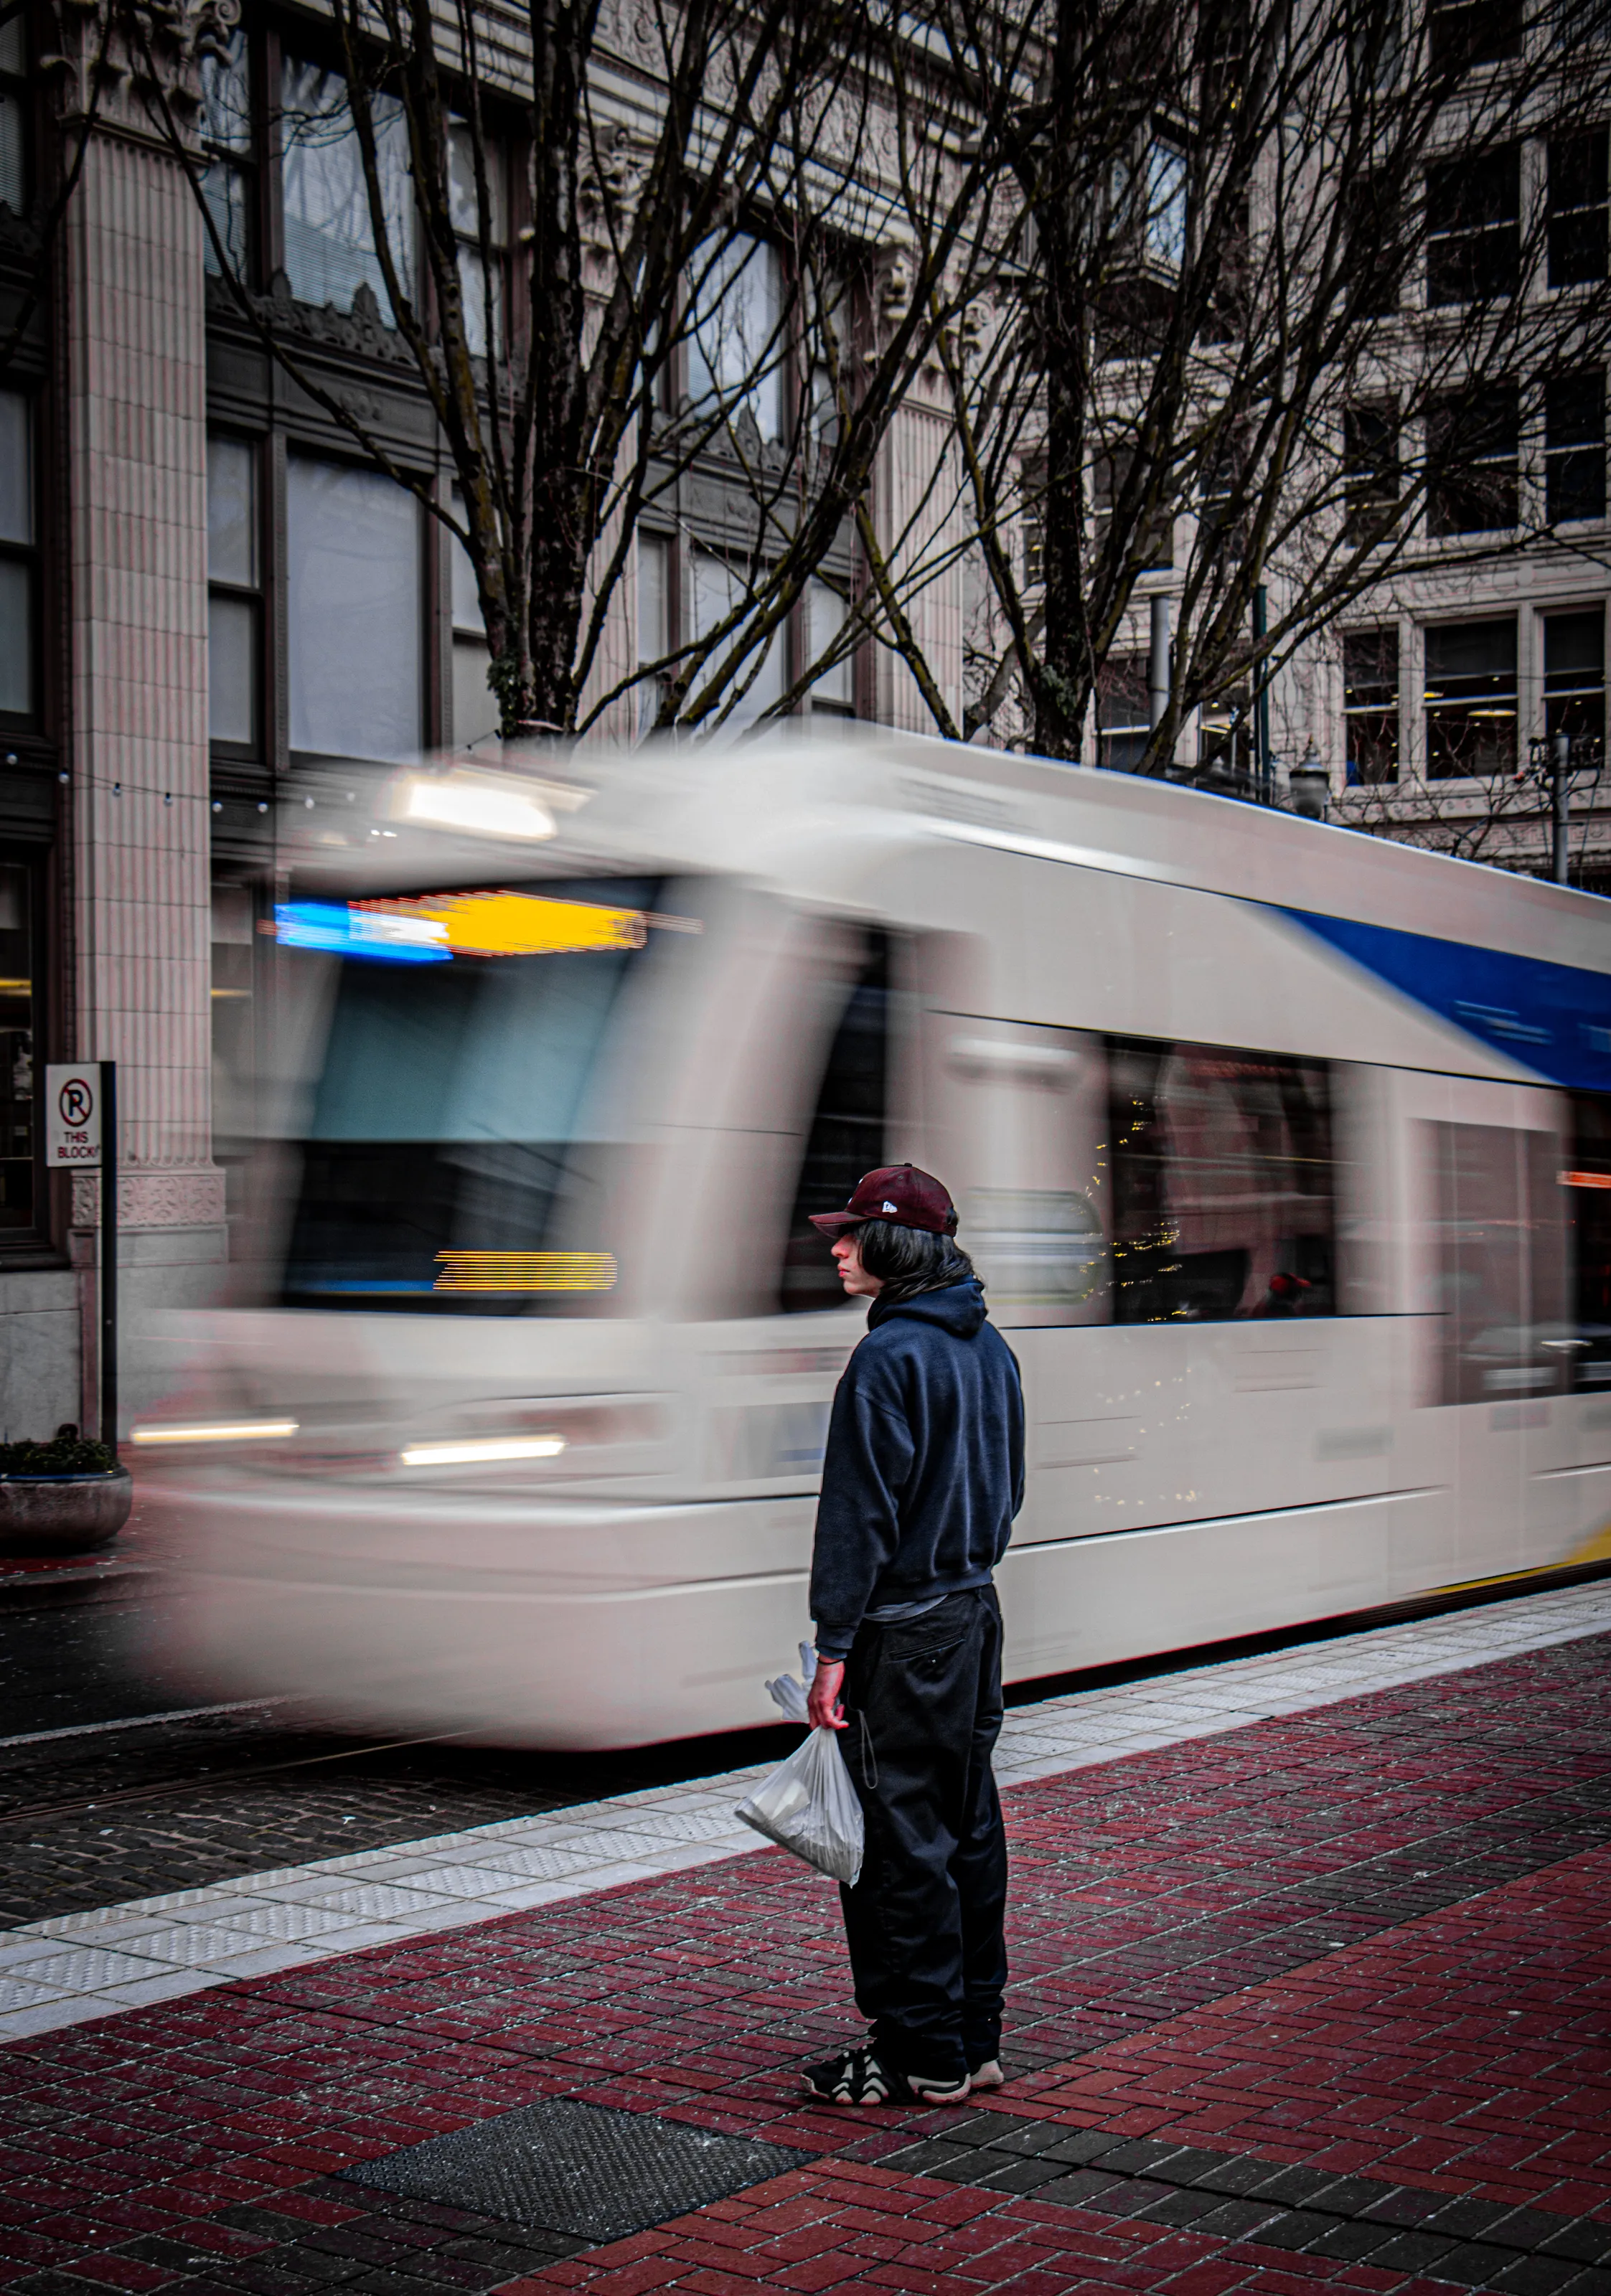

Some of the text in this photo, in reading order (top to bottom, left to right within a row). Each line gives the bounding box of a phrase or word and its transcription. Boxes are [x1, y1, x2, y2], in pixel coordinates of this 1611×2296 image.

[68, 1089, 83, 1116] P
[64, 1131, 89, 1143] THIS
[57, 1147, 96, 1158] BLOCK
